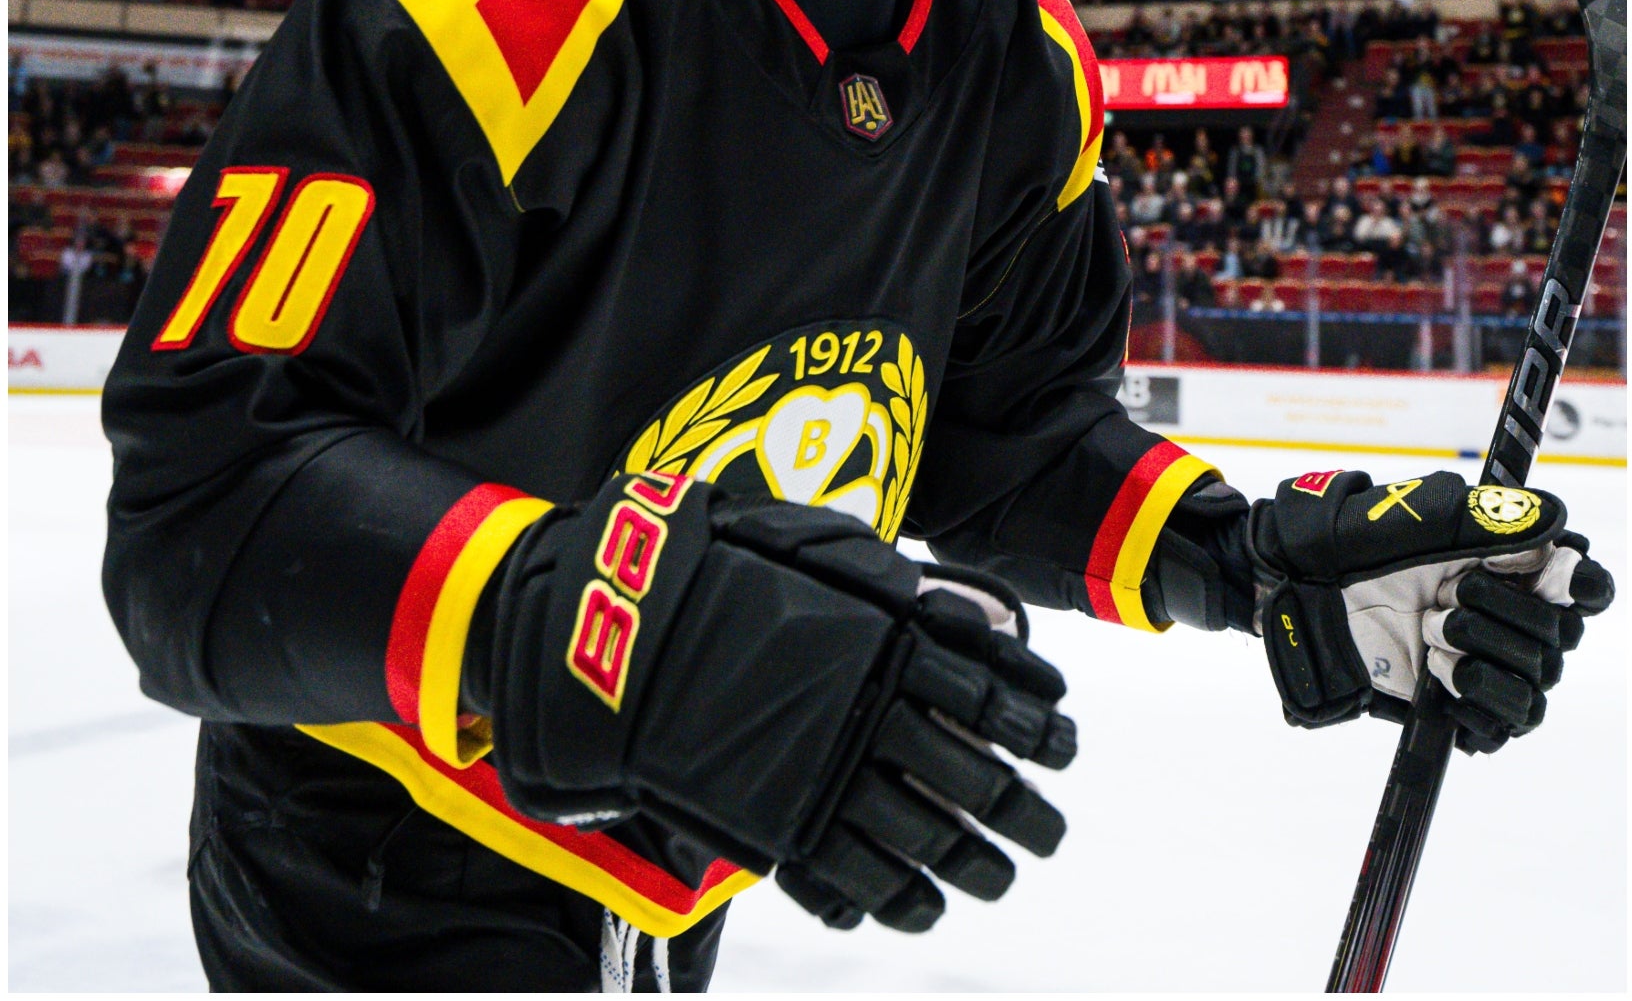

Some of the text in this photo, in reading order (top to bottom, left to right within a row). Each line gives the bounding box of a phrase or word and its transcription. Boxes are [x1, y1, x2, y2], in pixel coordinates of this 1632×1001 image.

[151, 165, 376, 357] 70
[789, 330, 883, 381] 1912
[794, 418, 832, 471] B
